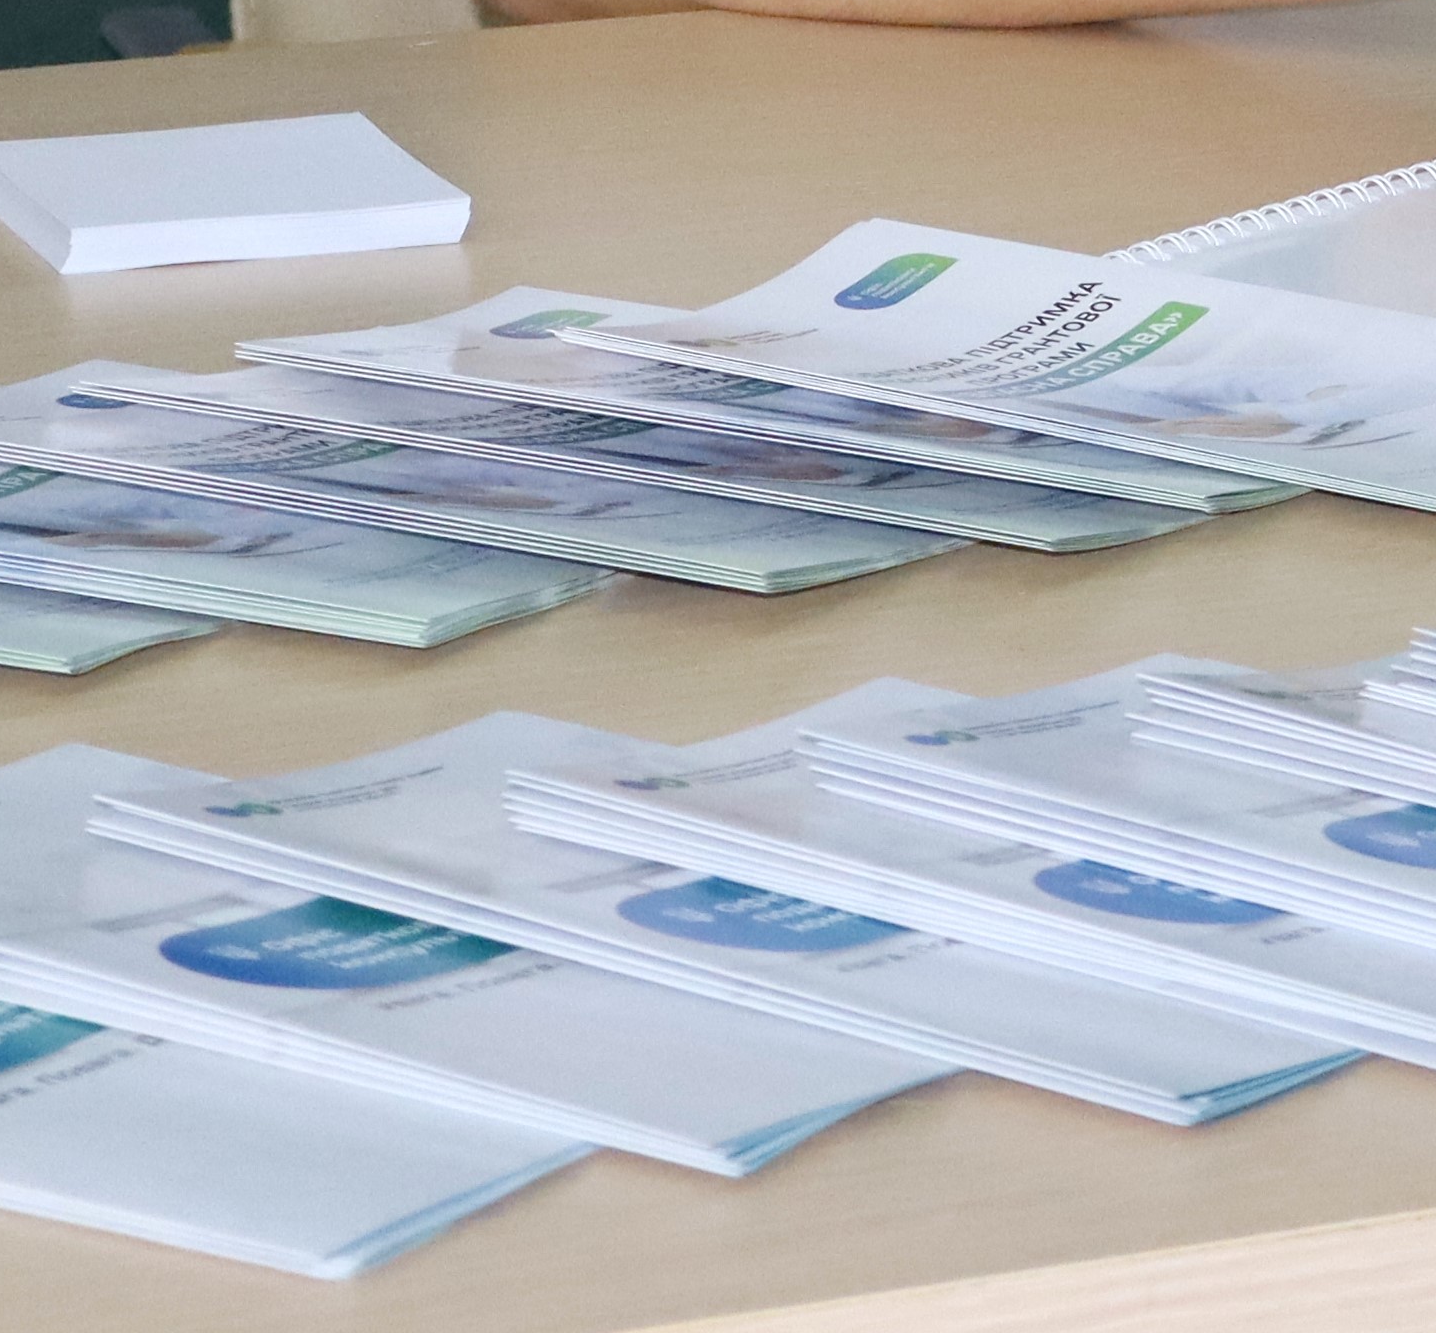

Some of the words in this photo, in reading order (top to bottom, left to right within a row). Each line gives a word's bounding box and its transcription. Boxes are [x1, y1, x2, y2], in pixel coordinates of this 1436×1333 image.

[966, 281, 1103, 358] ПІДТРИМКА
[998, 293, 1122, 370] ГРАНТОВОЇ
[1070, 311, 1183, 378] СПРАВА»
[968, 341, 1095, 386] ПРОГРАМИ
